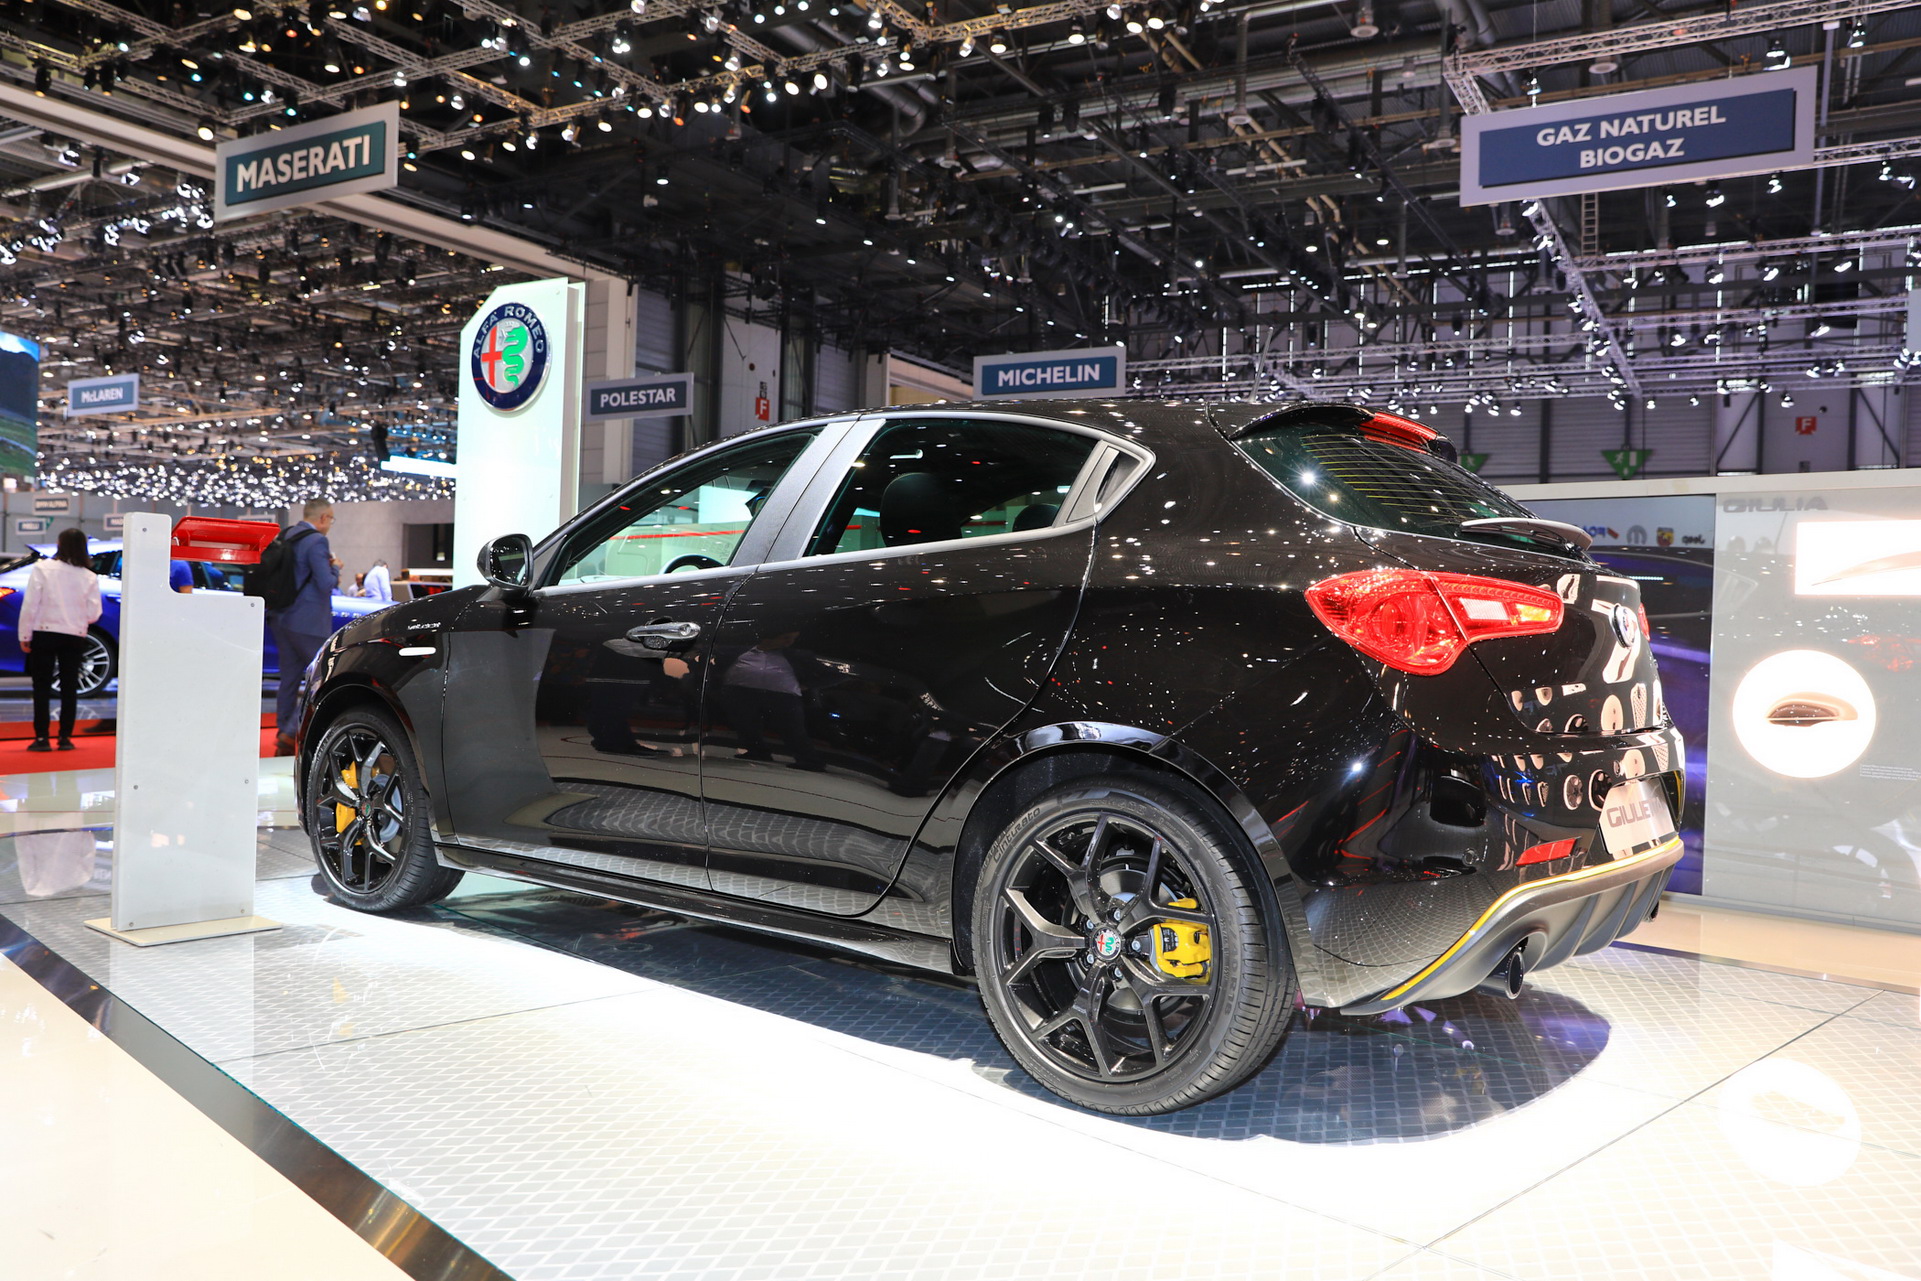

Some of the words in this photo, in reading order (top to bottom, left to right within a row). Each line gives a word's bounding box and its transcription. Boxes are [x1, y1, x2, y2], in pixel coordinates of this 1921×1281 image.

[1536, 122, 1592, 147] GAZ
[1600, 105, 1727, 139] NATUREL
[236, 134, 371, 193] MASERATI
[1579, 138, 1685, 169] BIOGAZ
[473, 311, 498, 359] ALFA
[504, 305, 544, 353] ROMEO
[998, 364, 1100, 387] MICHELIN
[81, 387, 124, 404] McLAREN
[600, 387, 677, 408] POLESTAR
[760, 399, 768, 415] F
[1802, 418, 1812, 431] F
[1723, 496, 1829, 513] GIULIA
